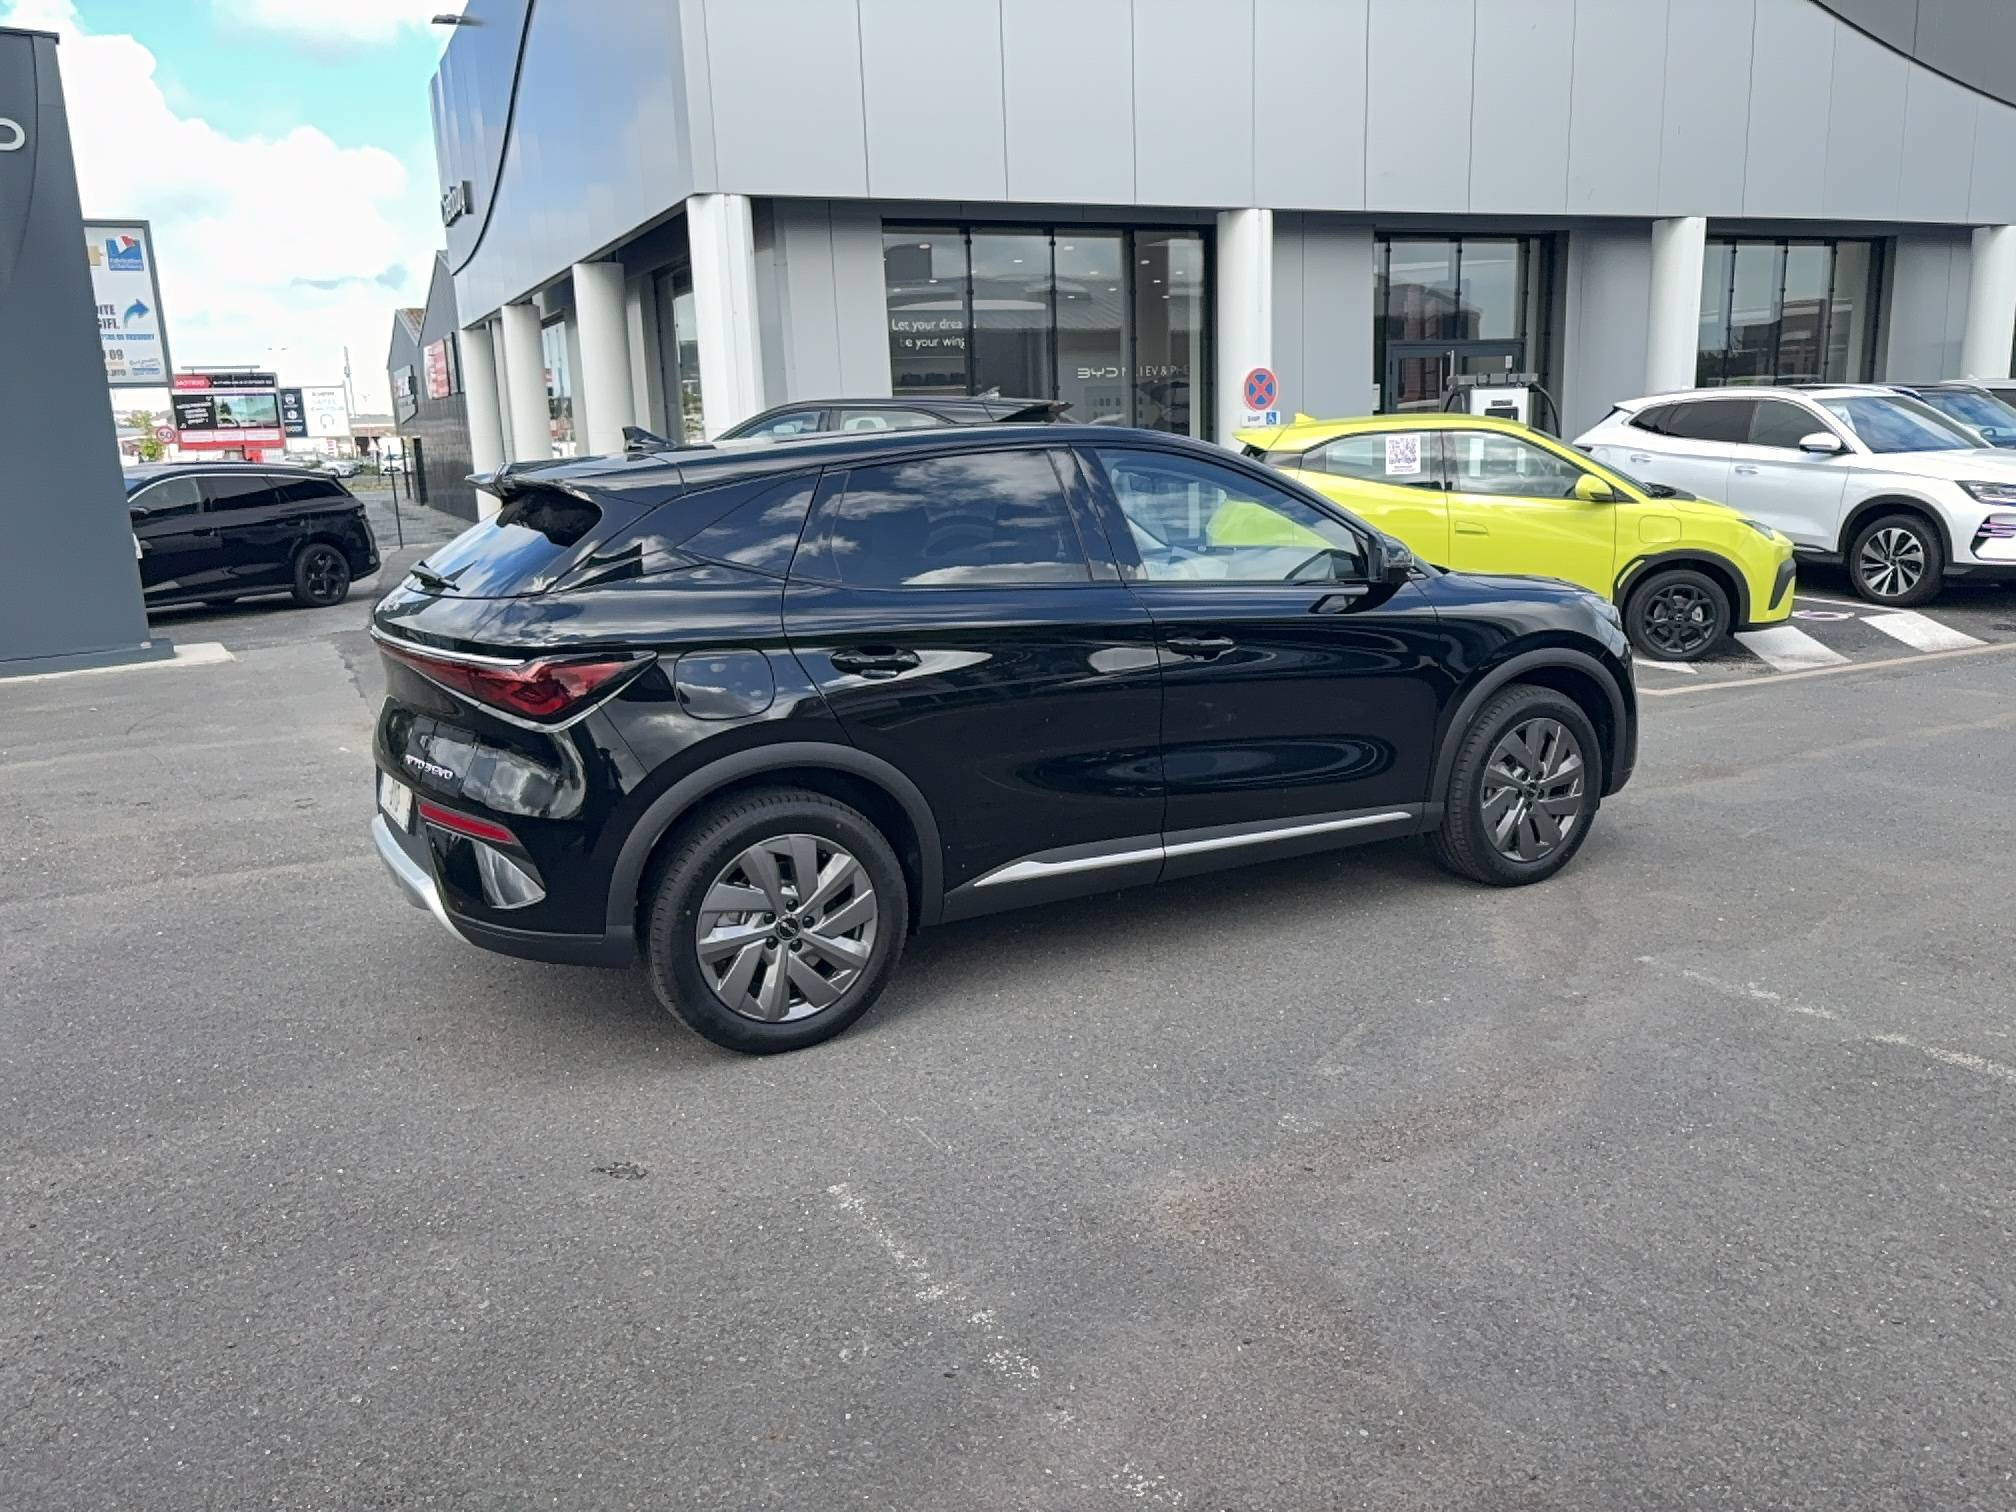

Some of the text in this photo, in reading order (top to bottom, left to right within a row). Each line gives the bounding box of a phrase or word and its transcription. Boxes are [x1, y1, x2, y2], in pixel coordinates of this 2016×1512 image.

[891, 318, 909, 330] Let
[911, 320, 937, 333] your
[915, 337, 939, 350] your
